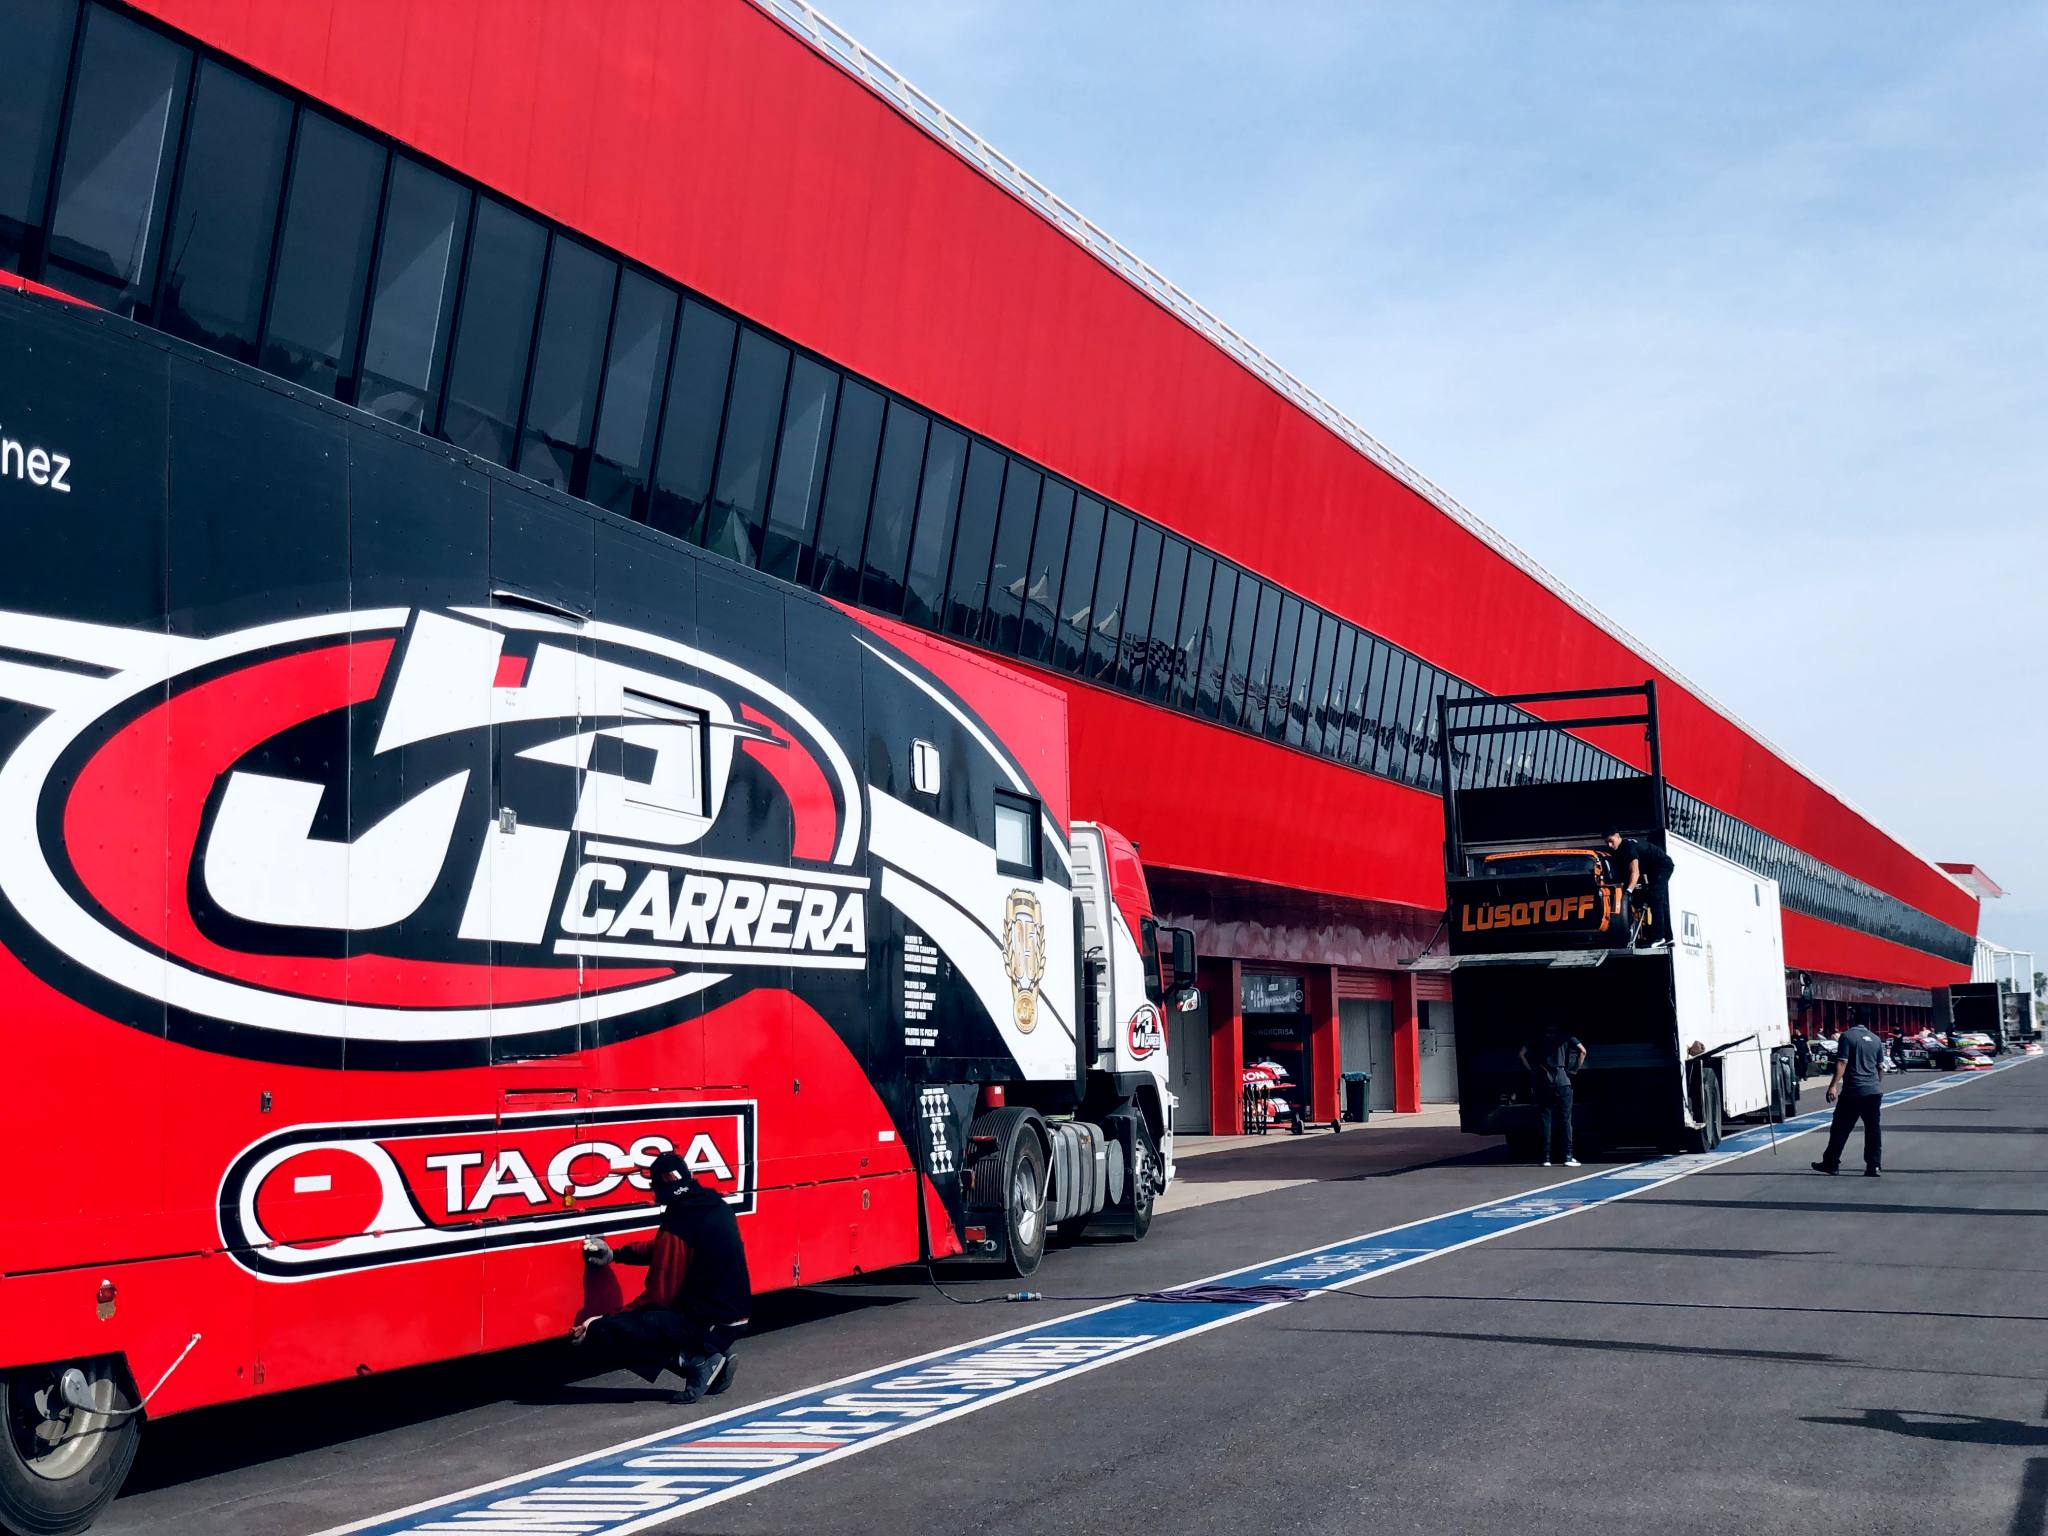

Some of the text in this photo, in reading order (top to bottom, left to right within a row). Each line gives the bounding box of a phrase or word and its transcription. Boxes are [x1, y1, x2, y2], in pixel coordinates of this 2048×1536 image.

[0, 424, 71, 492] nez
[560, 862, 867, 953] CARRERA
[426, 1133, 735, 1214] TACSA
[872, 1334, 1159, 1390] TERMAS
[776, 1393, 980, 1418] DE
[385, 1475, 748, 1536] HON
